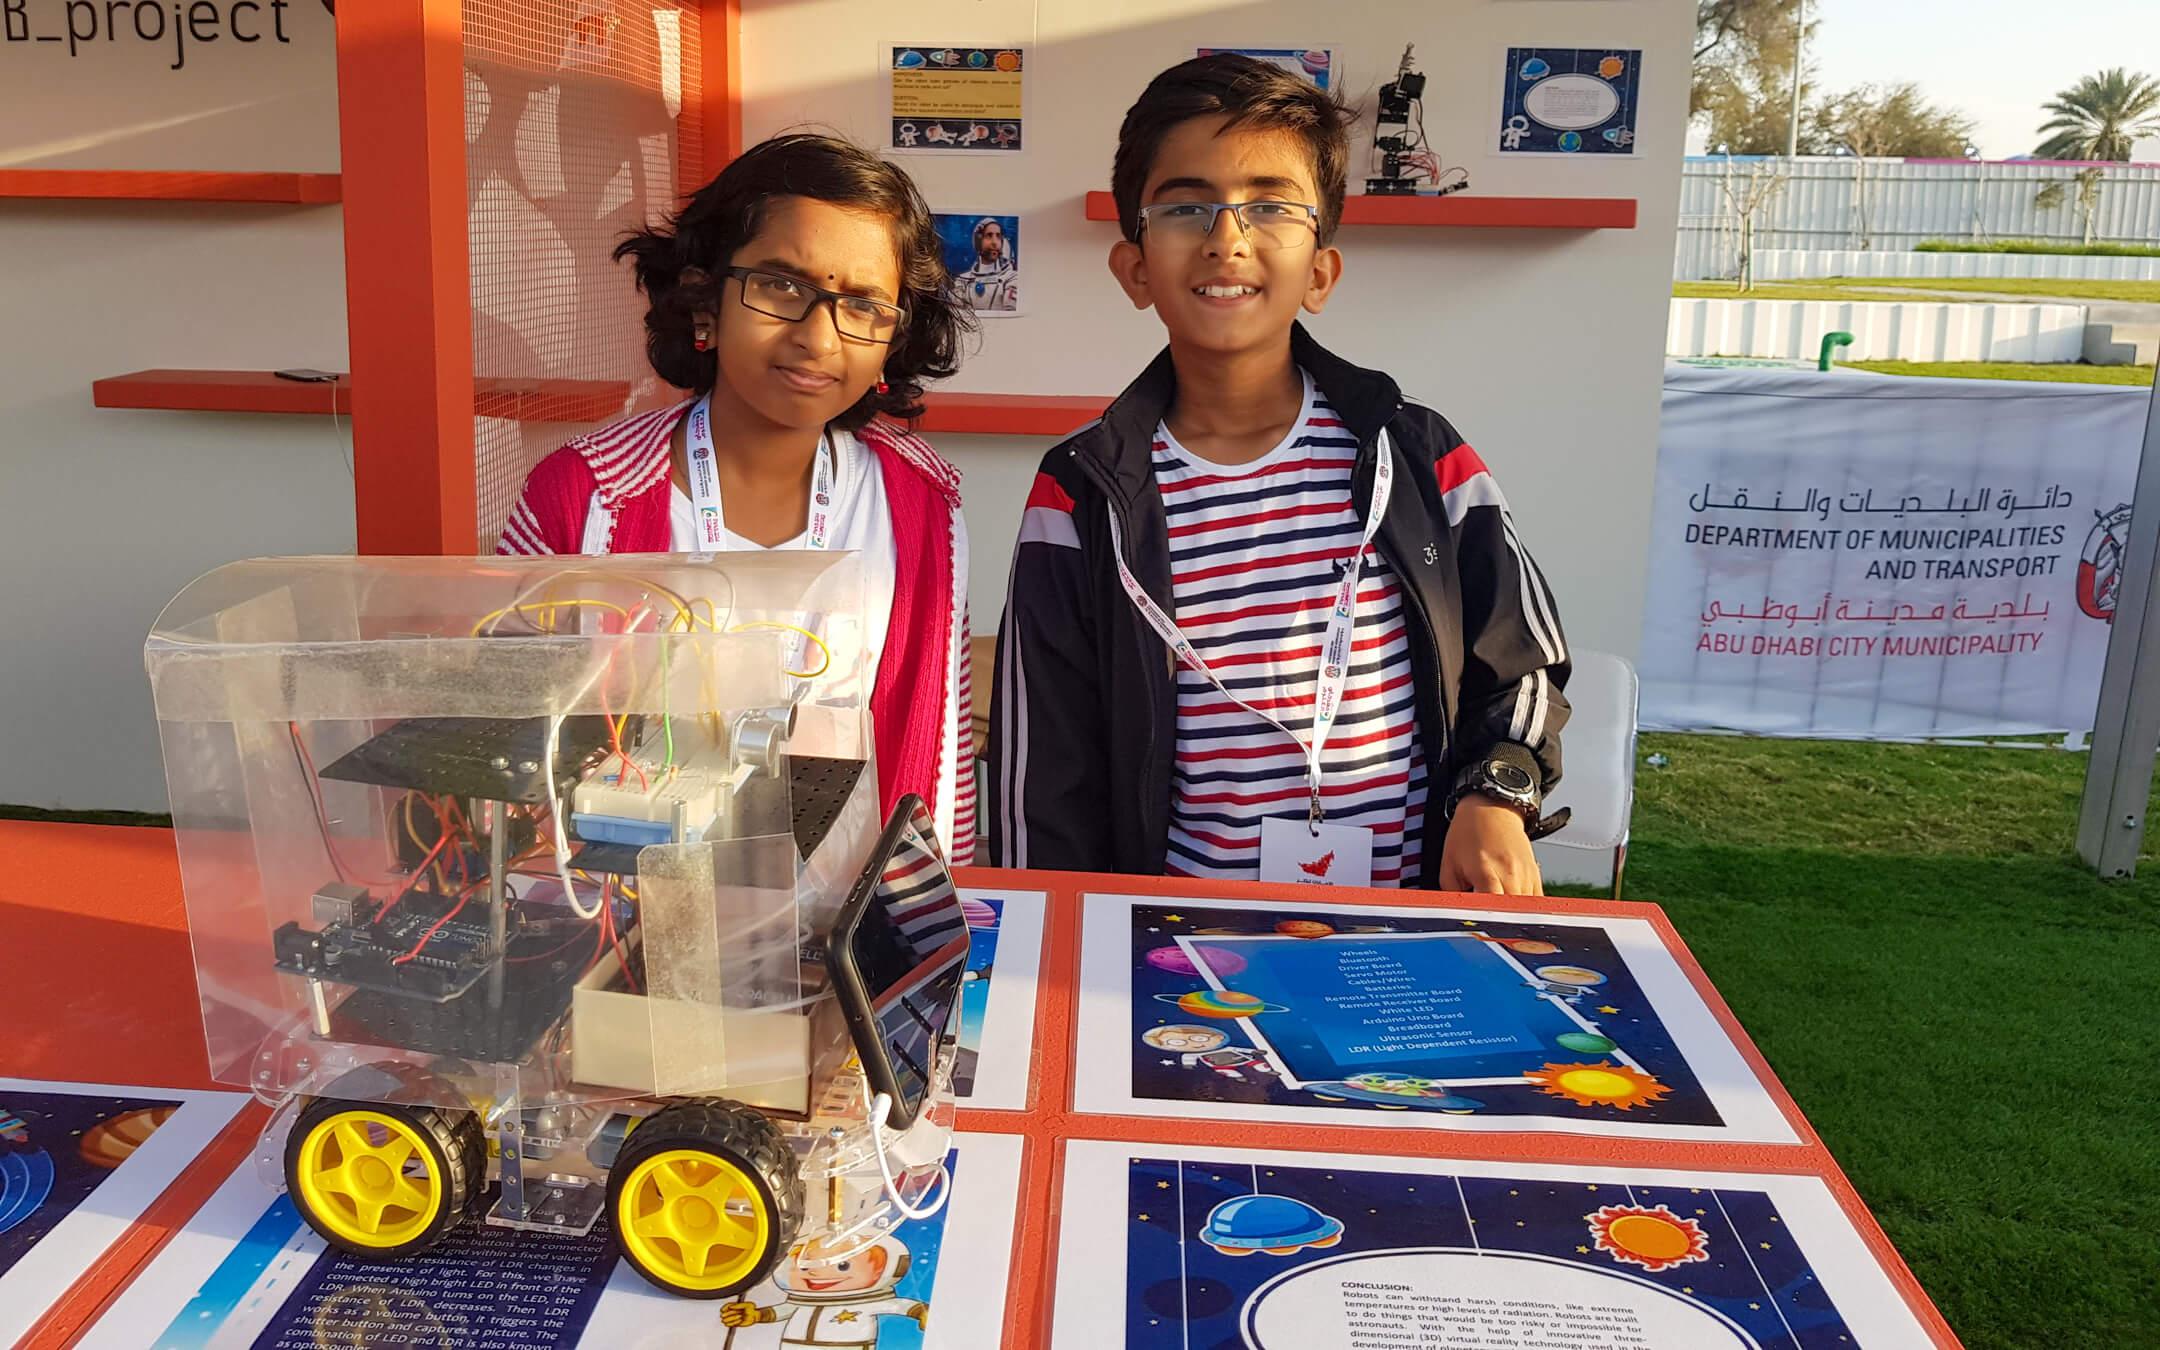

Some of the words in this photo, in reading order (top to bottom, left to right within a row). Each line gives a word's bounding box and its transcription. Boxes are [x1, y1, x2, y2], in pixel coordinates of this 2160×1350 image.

[1689, 483, 1831, 521] والنقل
[1840, 488, 1990, 518] البلديات
[1997, 485, 2072, 519] دائرة
[1685, 523, 1842, 549] DEPARTMENT
[1846, 529, 1875, 549] OF
[1879, 525, 2065, 550] MUNICIPALITIES
[1865, 560, 1916, 580] AND
[1923, 555, 2061, 579] TRANSPORT
[1701, 592, 1832, 629] أبوظبي
[1836, 599, 1945, 626] مدينة
[1952, 593, 2049, 624] بلدية
[1696, 632, 1745, 654] ABU
[1751, 635, 1822, 656] DHABI
[1829, 636, 1878, 656] CITY
[1882, 632, 2044, 656] MUNICIPALITY
[1339, 956, 1390, 964] Bluetooth
[1348, 976, 1416, 985] Cables/Wires
[1364, 984, 1412, 992] Batteries
[1369, 990, 1428, 1000] Transmitter
[1431, 988, 1462, 996] Board
[1382, 998, 1427, 1006] Receiver
[1429, 996, 1462, 1004] Board
[1362, 1016, 1406, 1025] Arduino
[1432, 1012, 1464, 1020] Board
[1378, 1007, 1412, 1015] White
[1378, 1032, 1435, 1042] Ultrasonic
[1437, 1030, 1473, 1038] Sensor
[1388, 1022, 1452, 1032] Breadboard
[1348, 1046, 1372, 1054] LDR
[1374, 1043, 1404, 1054] (Light
[1408, 1038, 1468, 1050] Dependent
[1470, 1035, 1518, 1045] Resistor)
[472, 1249, 507, 1257] within
[552, 1253, 584, 1262] value
[542, 1243, 603, 1252] connected
[335, 1262, 355, 1270] the
[359, 1264, 414, 1273] presence
[439, 1269, 468, 1278] light.
[475, 1270, 496, 1278] For
[502, 1271, 526, 1281] this,
[555, 1274, 587, 1284] have
[500, 1261, 524, 1269] LDR
[528, 1263, 576, 1273] changes
[580, 1265, 591, 1273] in
[318, 1282, 346, 1291] LDR.
[352, 1284, 386, 1294] When
[389, 1287, 438, 1297] Arduino
[442, 1291, 472, 1300] turns
[499, 1293, 519, 1302] the
[523, 1295, 550, 1304] LED,
[555, 1297, 576, 1305] the
[326, 1273, 389, 1283] connected
[403, 1277, 428, 1287] high
[430, 1278, 467, 1288] bright
[470, 1281, 494, 1289] LED
[496, 1282, 507, 1290] in
[511, 1282, 541, 1292] front
[544, 1284, 559, 1293] of
[561, 1286, 581, 1294] the
[1342, 1282, 1414, 1292] CONCLUSION:
[311, 1294, 371, 1305] resistance
[380, 1298, 394, 1306] of
[400, 1300, 426, 1308] LDR
[433, 1302, 496, 1313] decreases.
[506, 1305, 536, 1315] Then
[544, 1308, 570, 1317] LDR
[1344, 1292, 1379, 1300] Robots
[1410, 1295, 1461, 1304] withstand
[1467, 1298, 1496, 1306] harsh
[1591, 1306, 1634, 1314] extreme
[1344, 1301, 1415, 1312] temperatures
[1432, 1304, 1454, 1314] high
[1456, 1306, 1486, 1314] levels
[1555, 1312, 1592, 1320] Robots
[302, 1305, 340, 1315] works
[344, 1308, 357, 1316] as
[376, 1309, 422, 1320] volume
[476, 1315, 486, 1324] it
[490, 1316, 538, 1328] triggers
[543, 1319, 564, 1328] the
[1346, 1310, 1358, 1318] to
[1381, 1312, 1412, 1321] things
[1417, 1314, 1438, 1322] that
[1443, 1316, 1476, 1324] would
[1521, 1320, 1545, 1328] risky
[1566, 1322, 1622, 1332] impossible
[293, 1316, 340, 1326] shutter
[341, 1319, 386, 1330] button
[388, 1322, 412, 1331] and
[414, 1324, 468, 1336] captures
[472, 1328, 480, 1336] a
[482, 1327, 530, 1338] picture.
[536, 1330, 558, 1340] The
[1420, 1324, 1446, 1332] With
[1488, 1327, 1510, 1336] help
[1546, 1330, 1602, 1340] innovative
[276, 1340, 290, 1348] as
[285, 1328, 362, 1340] combination
[366, 1333, 380, 1341] of
[382, 1334, 408, 1343] LED
[410, 1336, 435, 1346] and
[438, 1337, 464, 1347] LDR
[466, 1338, 476, 1348] is
[480, 1340, 506, 1350] also
[508, 1341, 552, 1350] known
[1350, 1330, 1414, 1340] dimensional
[1420, 1334, 1442, 1342] (3D)
[1447, 1336, 1481, 1344] virtual
[1486, 1338, 1518, 1347] reality
[1524, 1339, 1583, 1350] technology
